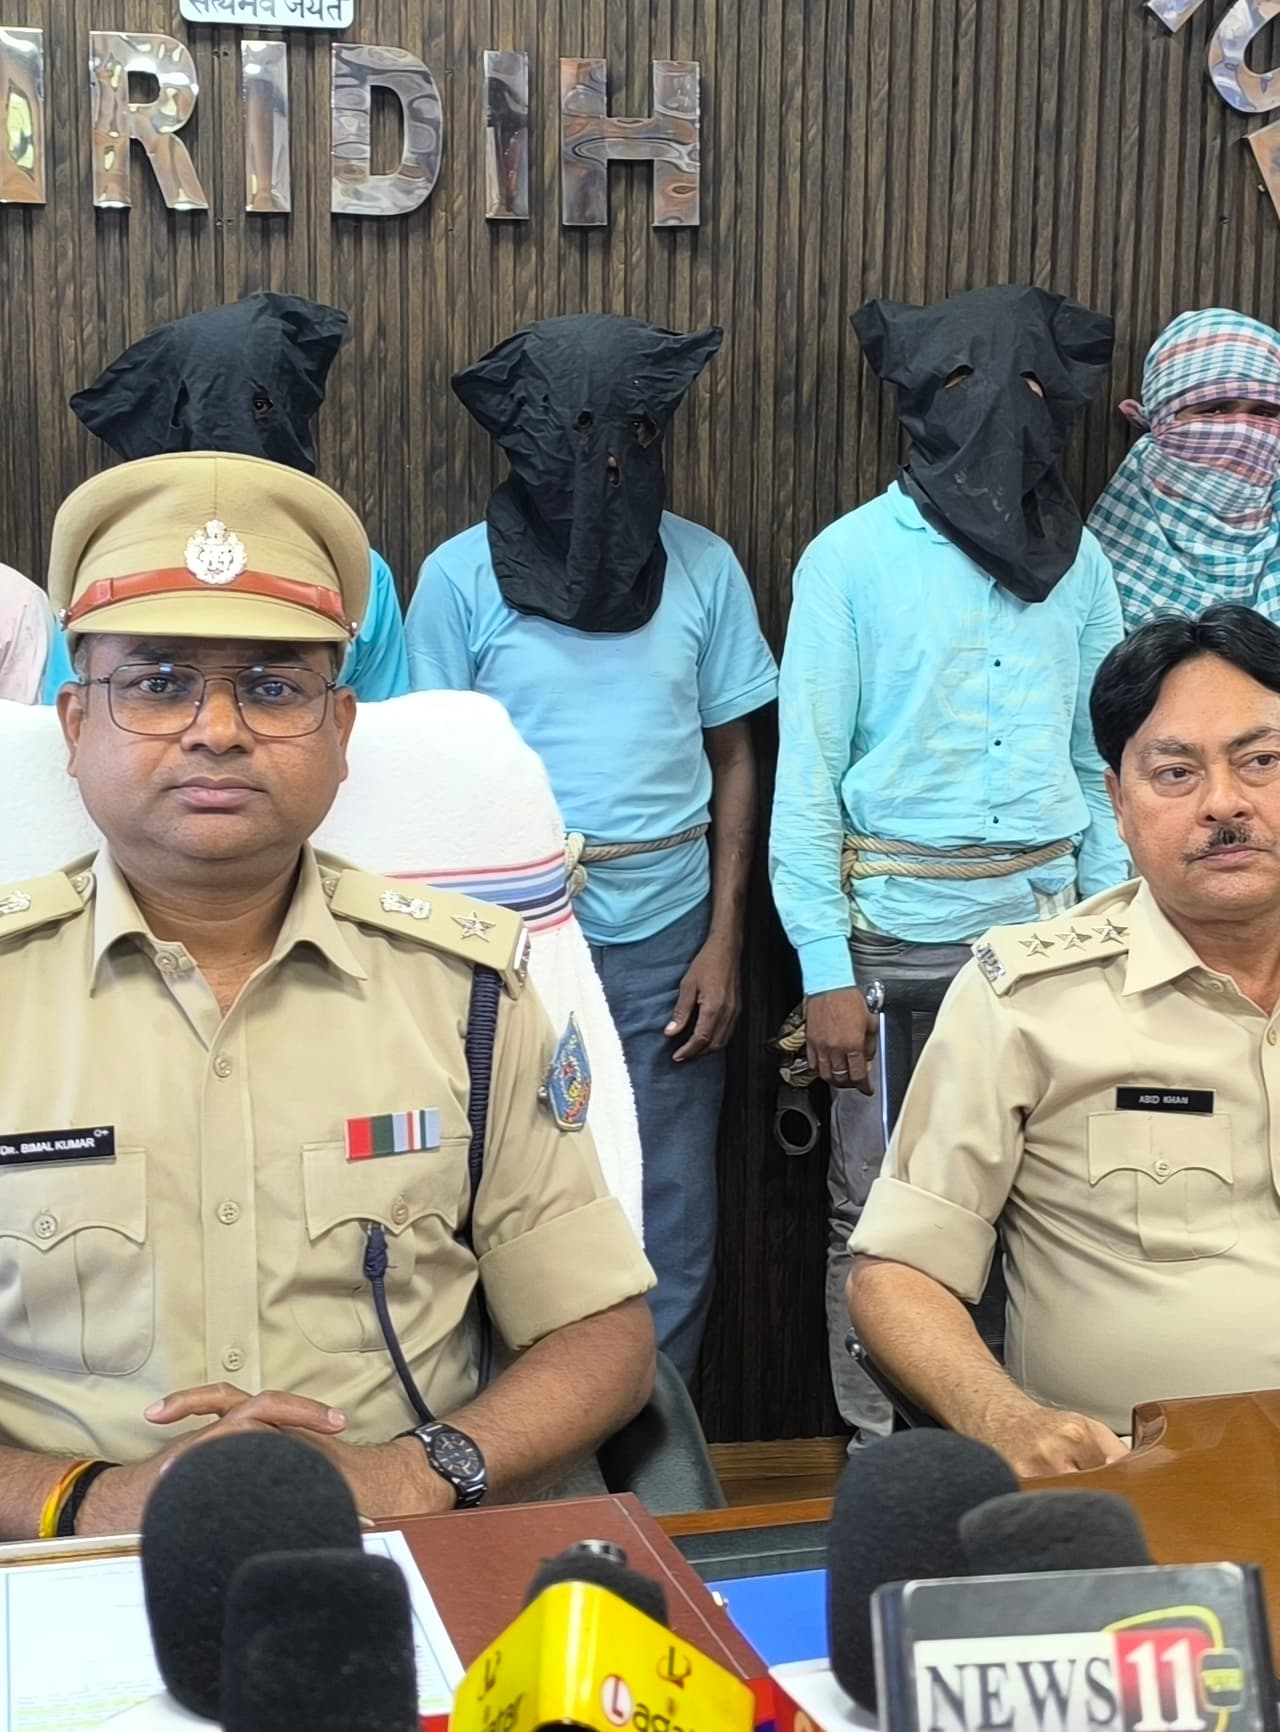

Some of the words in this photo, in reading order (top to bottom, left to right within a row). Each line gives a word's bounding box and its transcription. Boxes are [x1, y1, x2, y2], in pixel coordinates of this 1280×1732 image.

[1138, 1095, 1161, 1104] ABID
[1162, 1095, 1189, 1105] KHAN
[20, 1141, 55, 1153] BIMAL
[54, 1137, 96, 1151] KUMAR
[925, 1656, 1119, 1732] NEWS
[1125, 1638, 1207, 1732] 11
